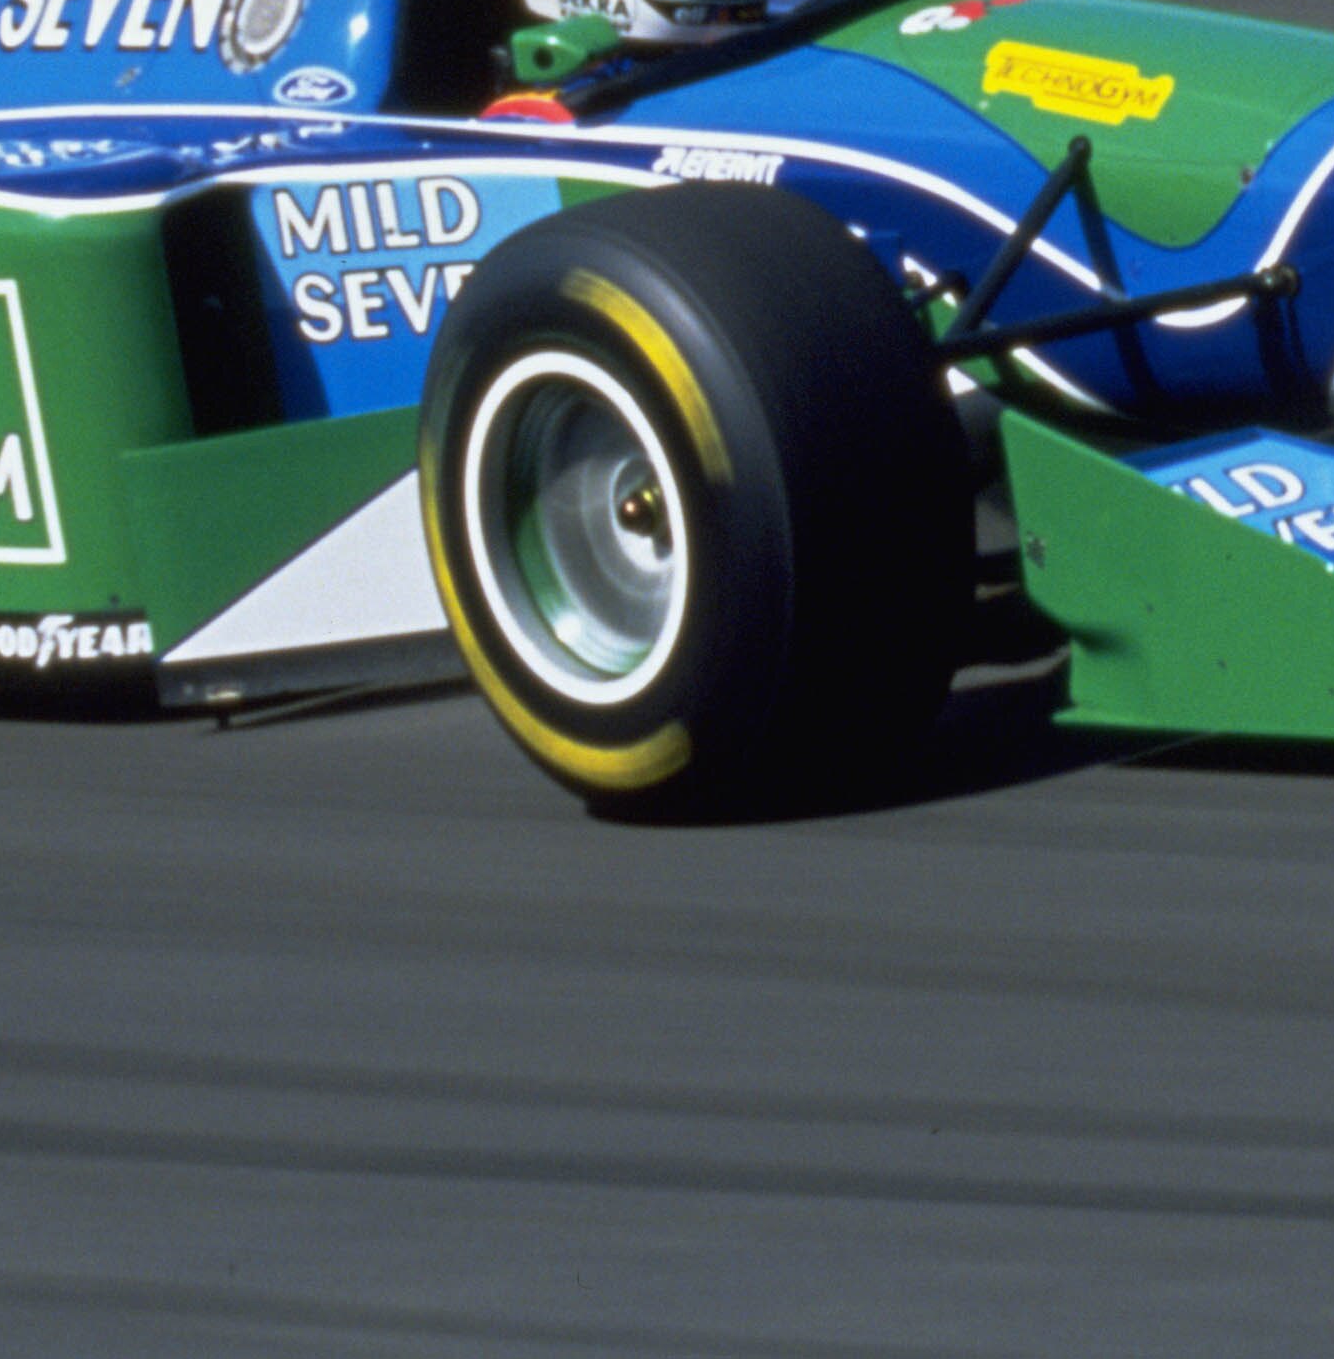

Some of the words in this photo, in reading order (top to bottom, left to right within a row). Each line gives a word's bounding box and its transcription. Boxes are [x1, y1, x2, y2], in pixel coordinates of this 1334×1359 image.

[272, 176, 481, 258] MILD
[294, 263, 475, 342] SEV
[1171, 463, 1305, 518] LD
